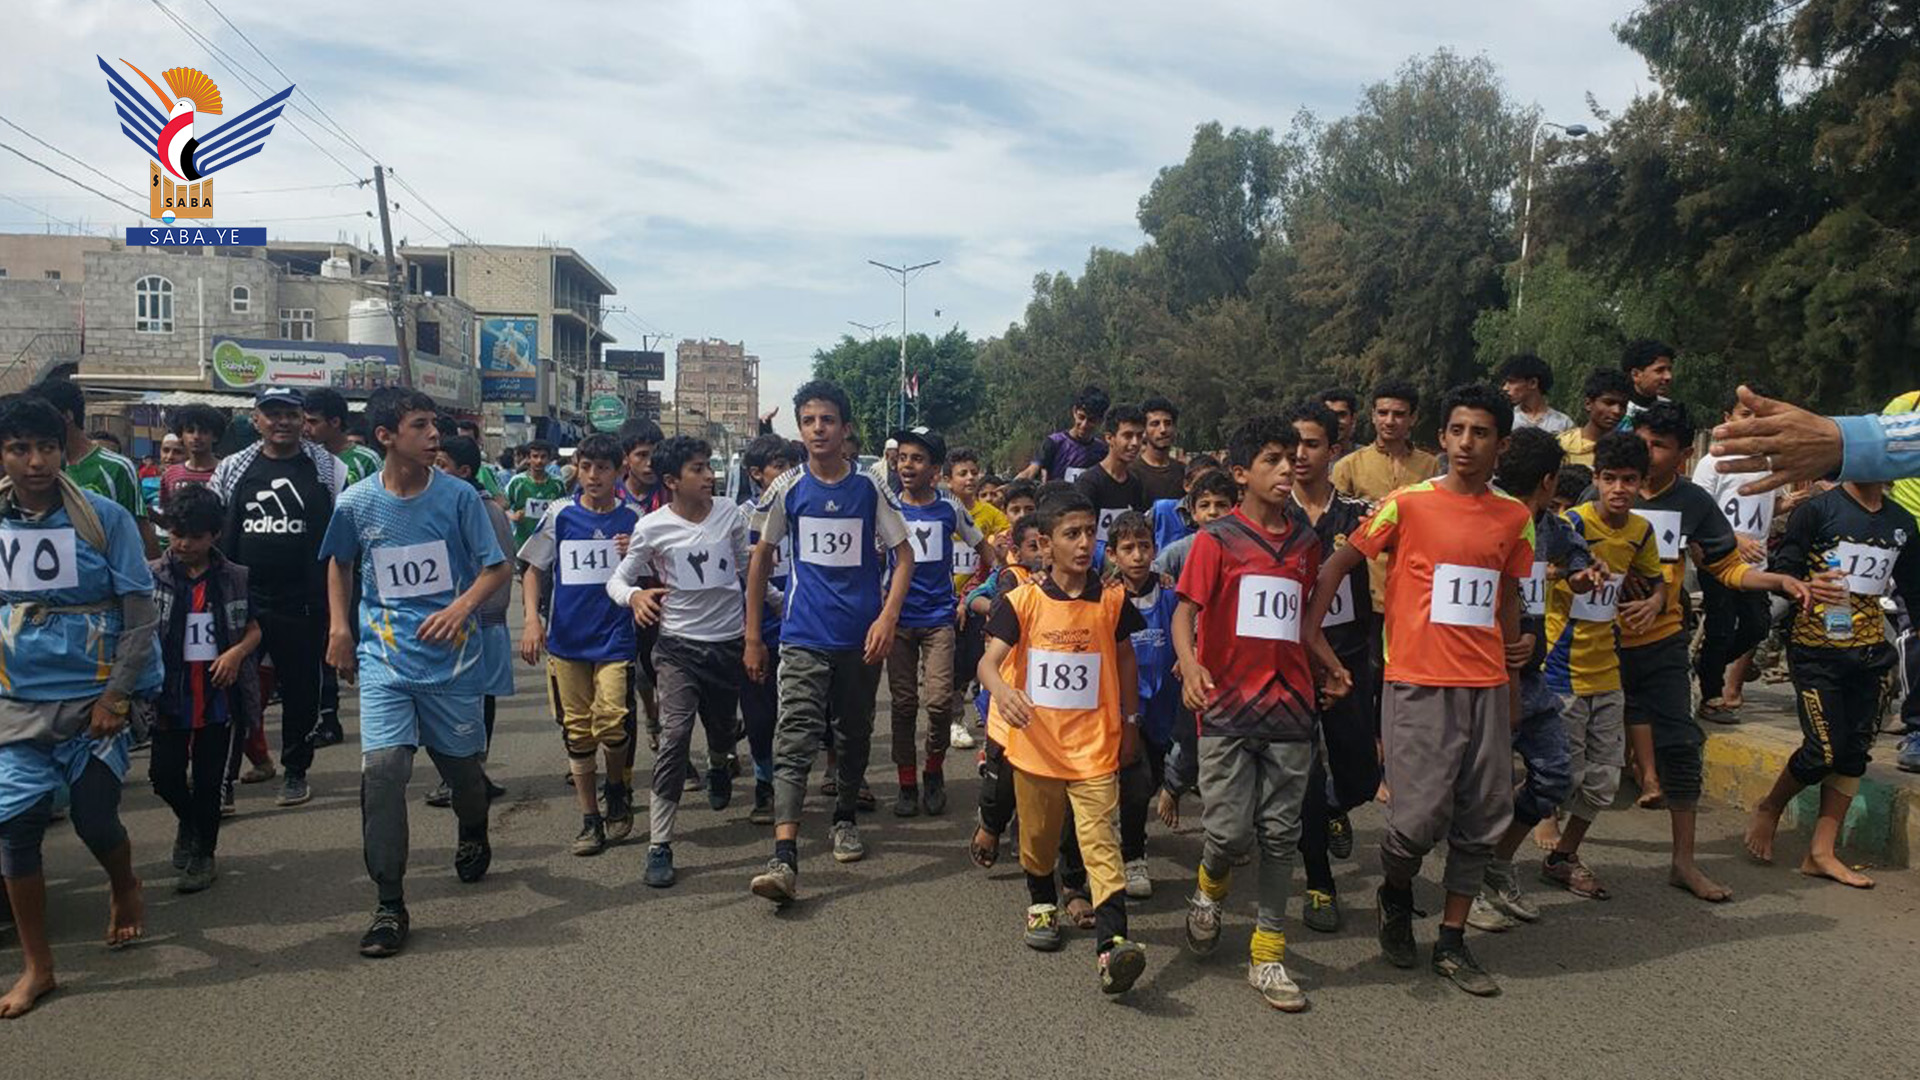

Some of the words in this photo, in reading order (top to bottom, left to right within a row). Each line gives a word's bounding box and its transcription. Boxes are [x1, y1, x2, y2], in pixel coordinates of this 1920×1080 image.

[242, 515, 306, 534] adida
[1724, 497, 1763, 531] ٩٨
[810, 531, 853, 555] 139
[0, 537, 61, 582] ٧٥
[387, 557, 440, 588] 102
[570, 548, 610, 570] 141
[687, 550, 728, 585] ٣٠
[1848, 553, 1890, 581] 123
[1253, 590, 1299, 622] 109
[1448, 576, 1493, 608] 112
[1037, 662, 1088, 691] 183
